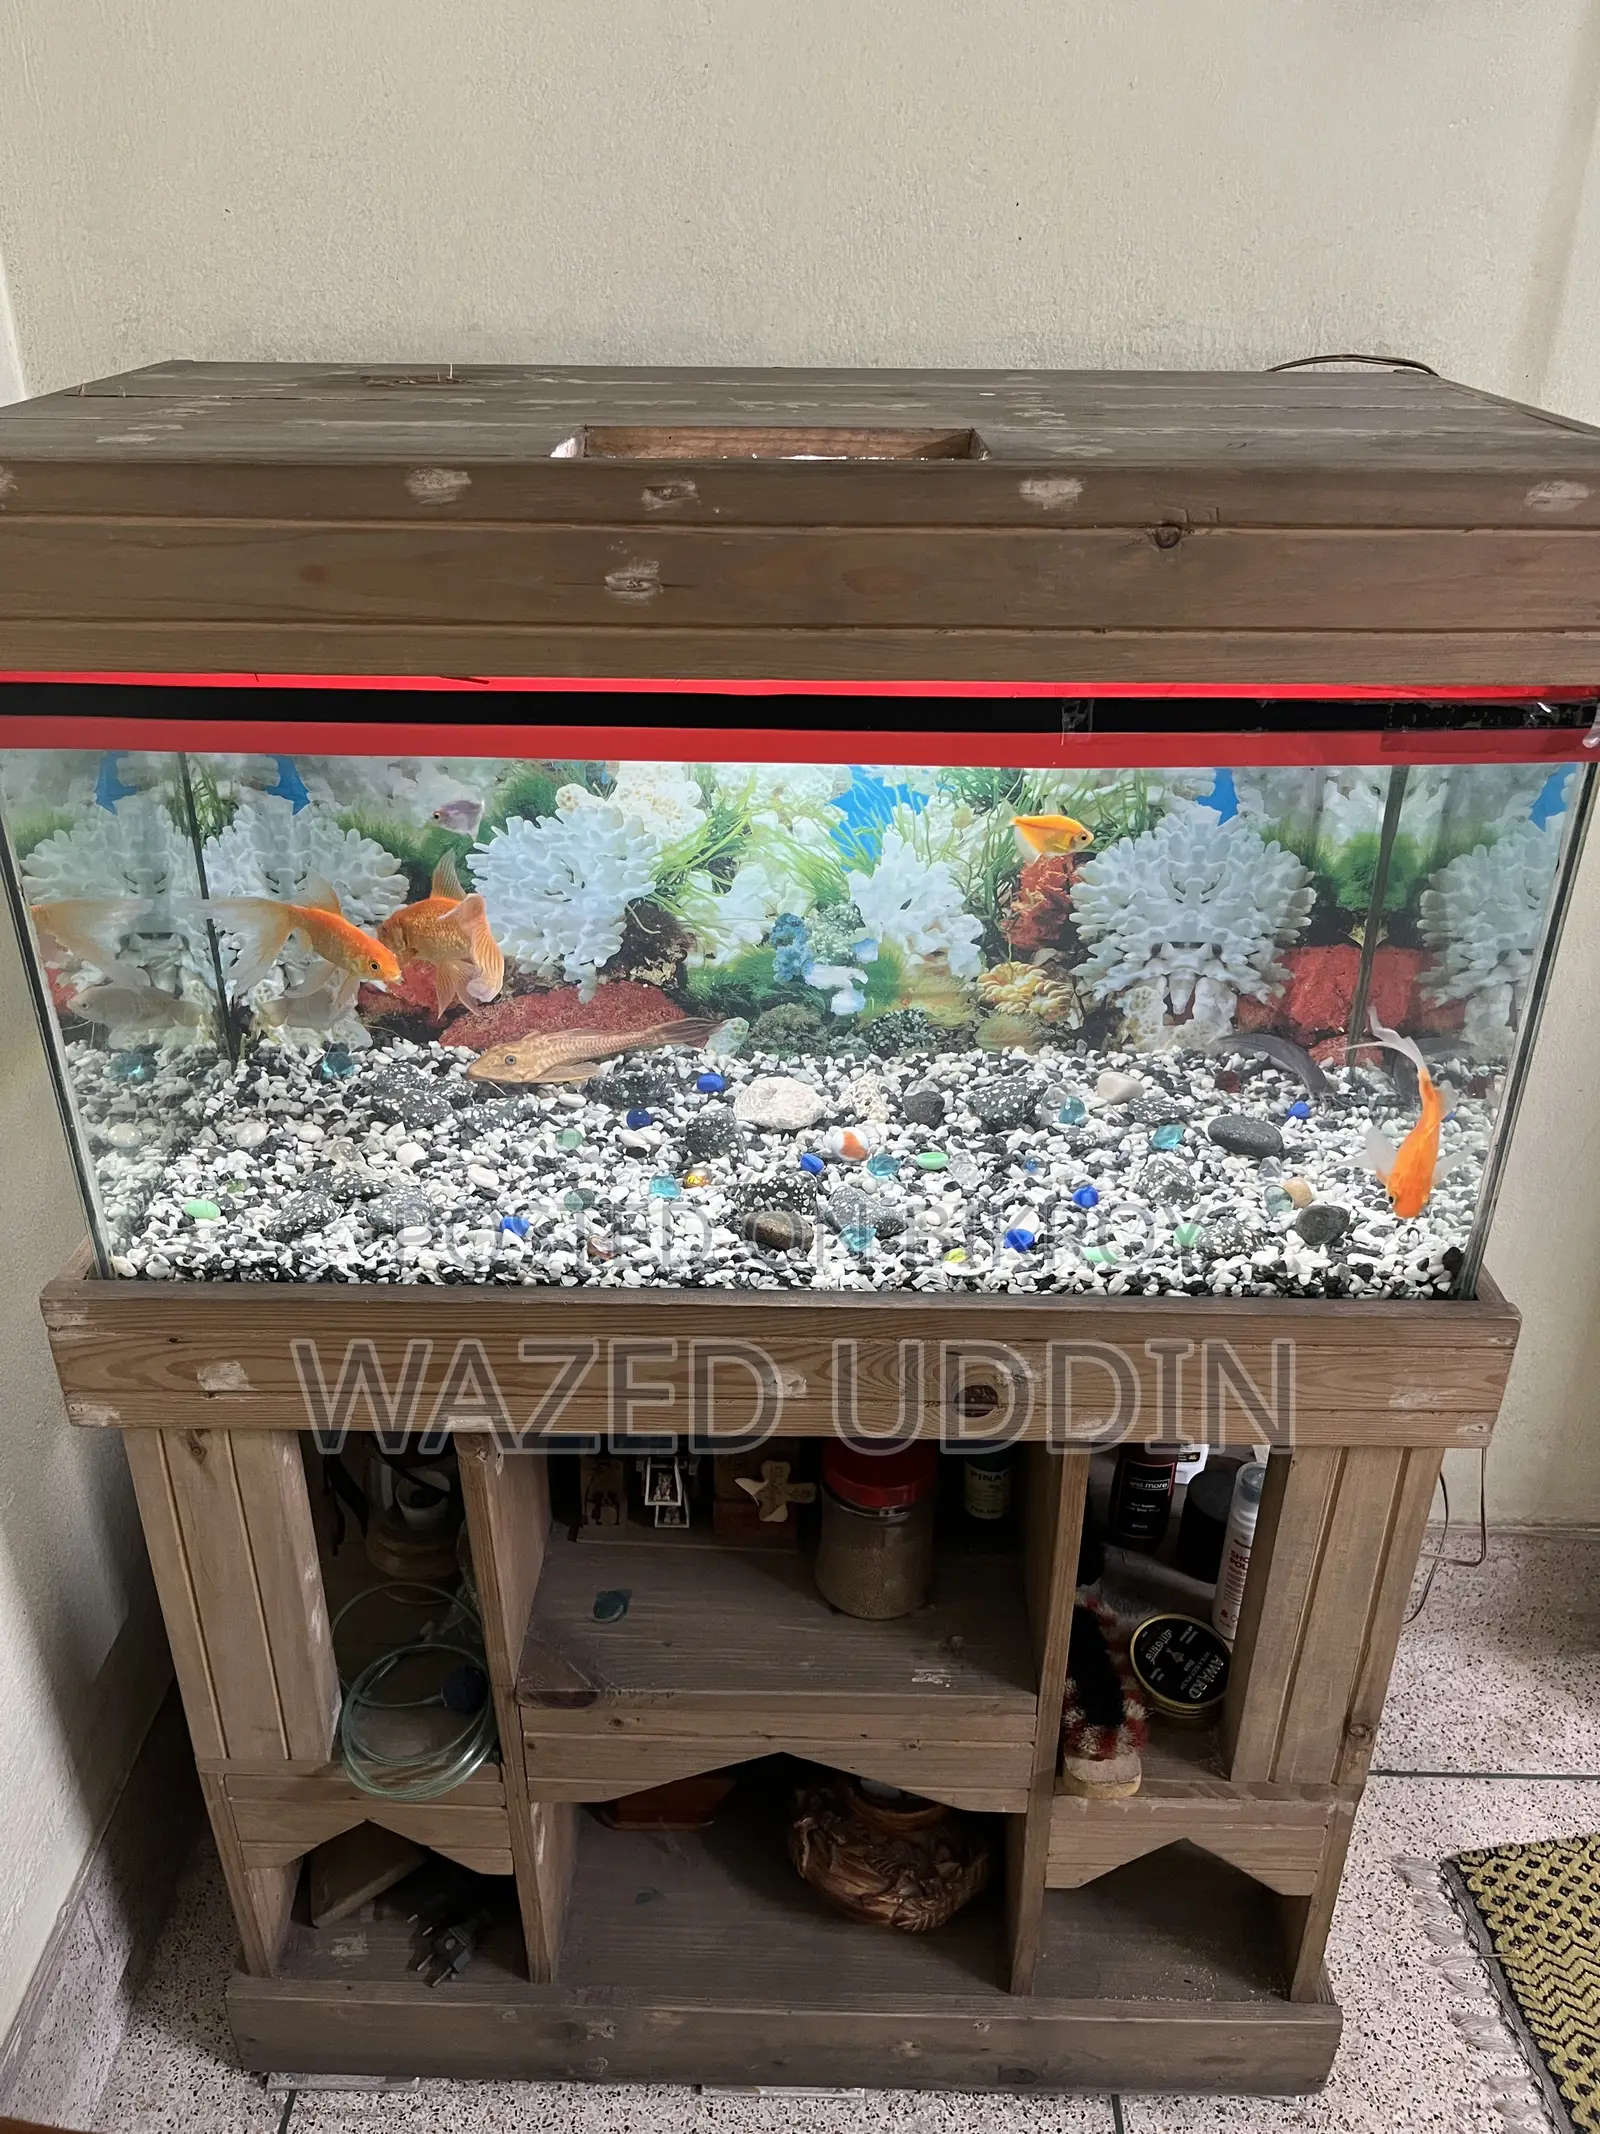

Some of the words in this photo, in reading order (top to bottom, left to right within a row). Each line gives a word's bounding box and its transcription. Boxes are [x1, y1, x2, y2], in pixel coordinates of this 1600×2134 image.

[1229, 1556, 1249, 1571] POL
[1230, 1549, 1250, 1565] SHO
[1188, 1654, 1225, 1699] AWARD
